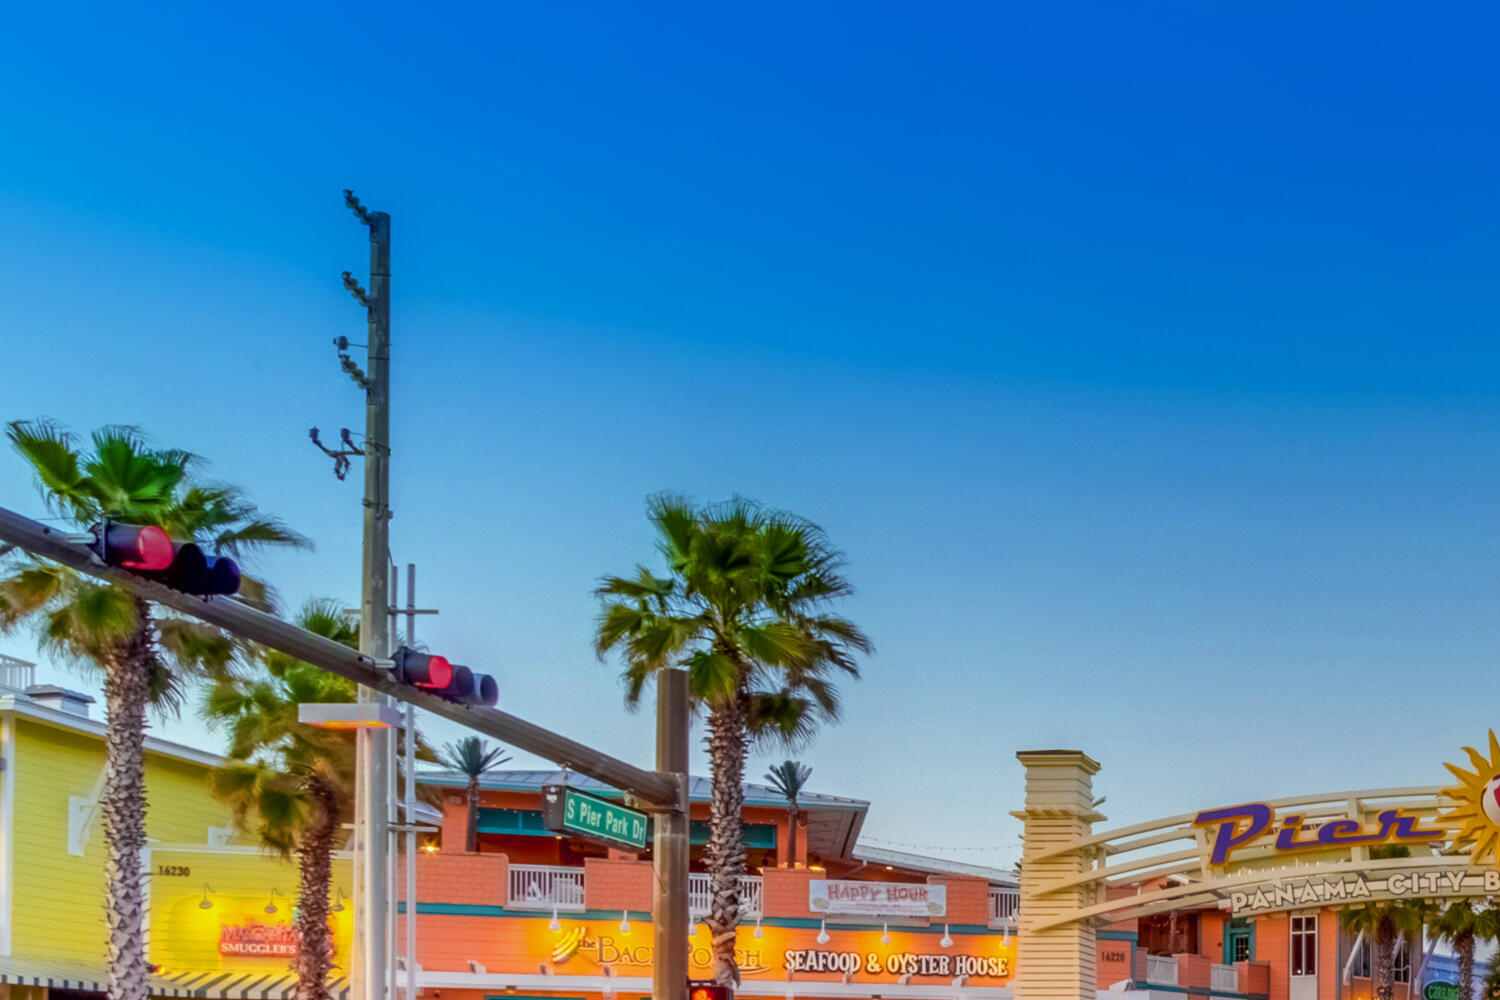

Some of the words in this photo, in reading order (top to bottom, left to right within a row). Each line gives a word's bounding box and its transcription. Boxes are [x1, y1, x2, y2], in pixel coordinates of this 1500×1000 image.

[566, 798, 576, 820] S
[580, 802, 603, 828] Pier
[605, 809, 628, 837] Park
[632, 818, 645, 841] Dr
[1193, 802, 1447, 867] Pier
[158, 865, 190, 877] 16230
[827, 884, 882, 901] HAPPY
[886, 886, 929, 903] HOUR
[1230, 873, 1372, 914] PANAMA
[1386, 870, 1467, 896] CITY
[221, 942, 297, 954] SMUGGLER'S
[577, 934, 598, 948] the
[597, 936, 654, 966] BAC
[687, 942, 764, 969] OCH
[784, 950, 862, 973] SEAFOOD
[866, 953, 882, 973] &
[887, 954, 950, 976] OYSTER
[954, 956, 1008, 977] HOUSE
